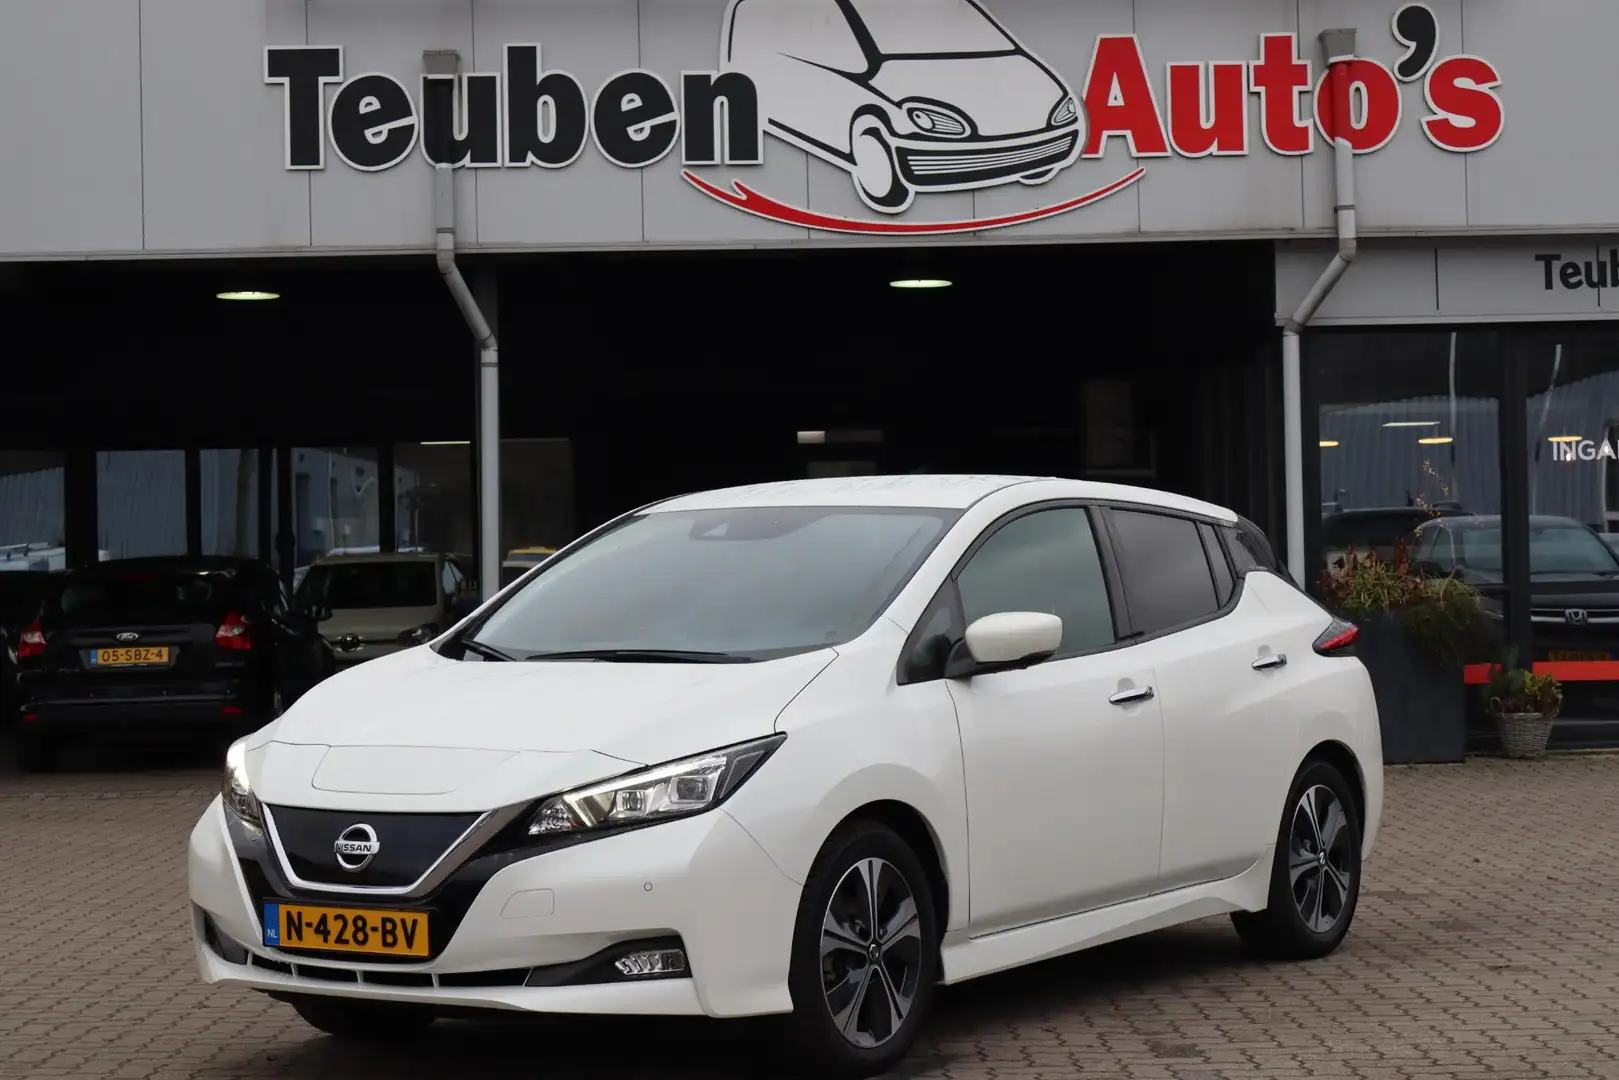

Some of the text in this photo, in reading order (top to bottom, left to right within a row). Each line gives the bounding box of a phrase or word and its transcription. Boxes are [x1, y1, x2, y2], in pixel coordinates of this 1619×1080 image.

[265, 3, 1504, 169] Teuben Auto's
[1552, 439, 1619, 460] INGA
[102, 648, 163, 662] 05-SBZ-4
[335, 843, 372, 853] NISSAN
[286, 910, 418, 950] N-428-BV
